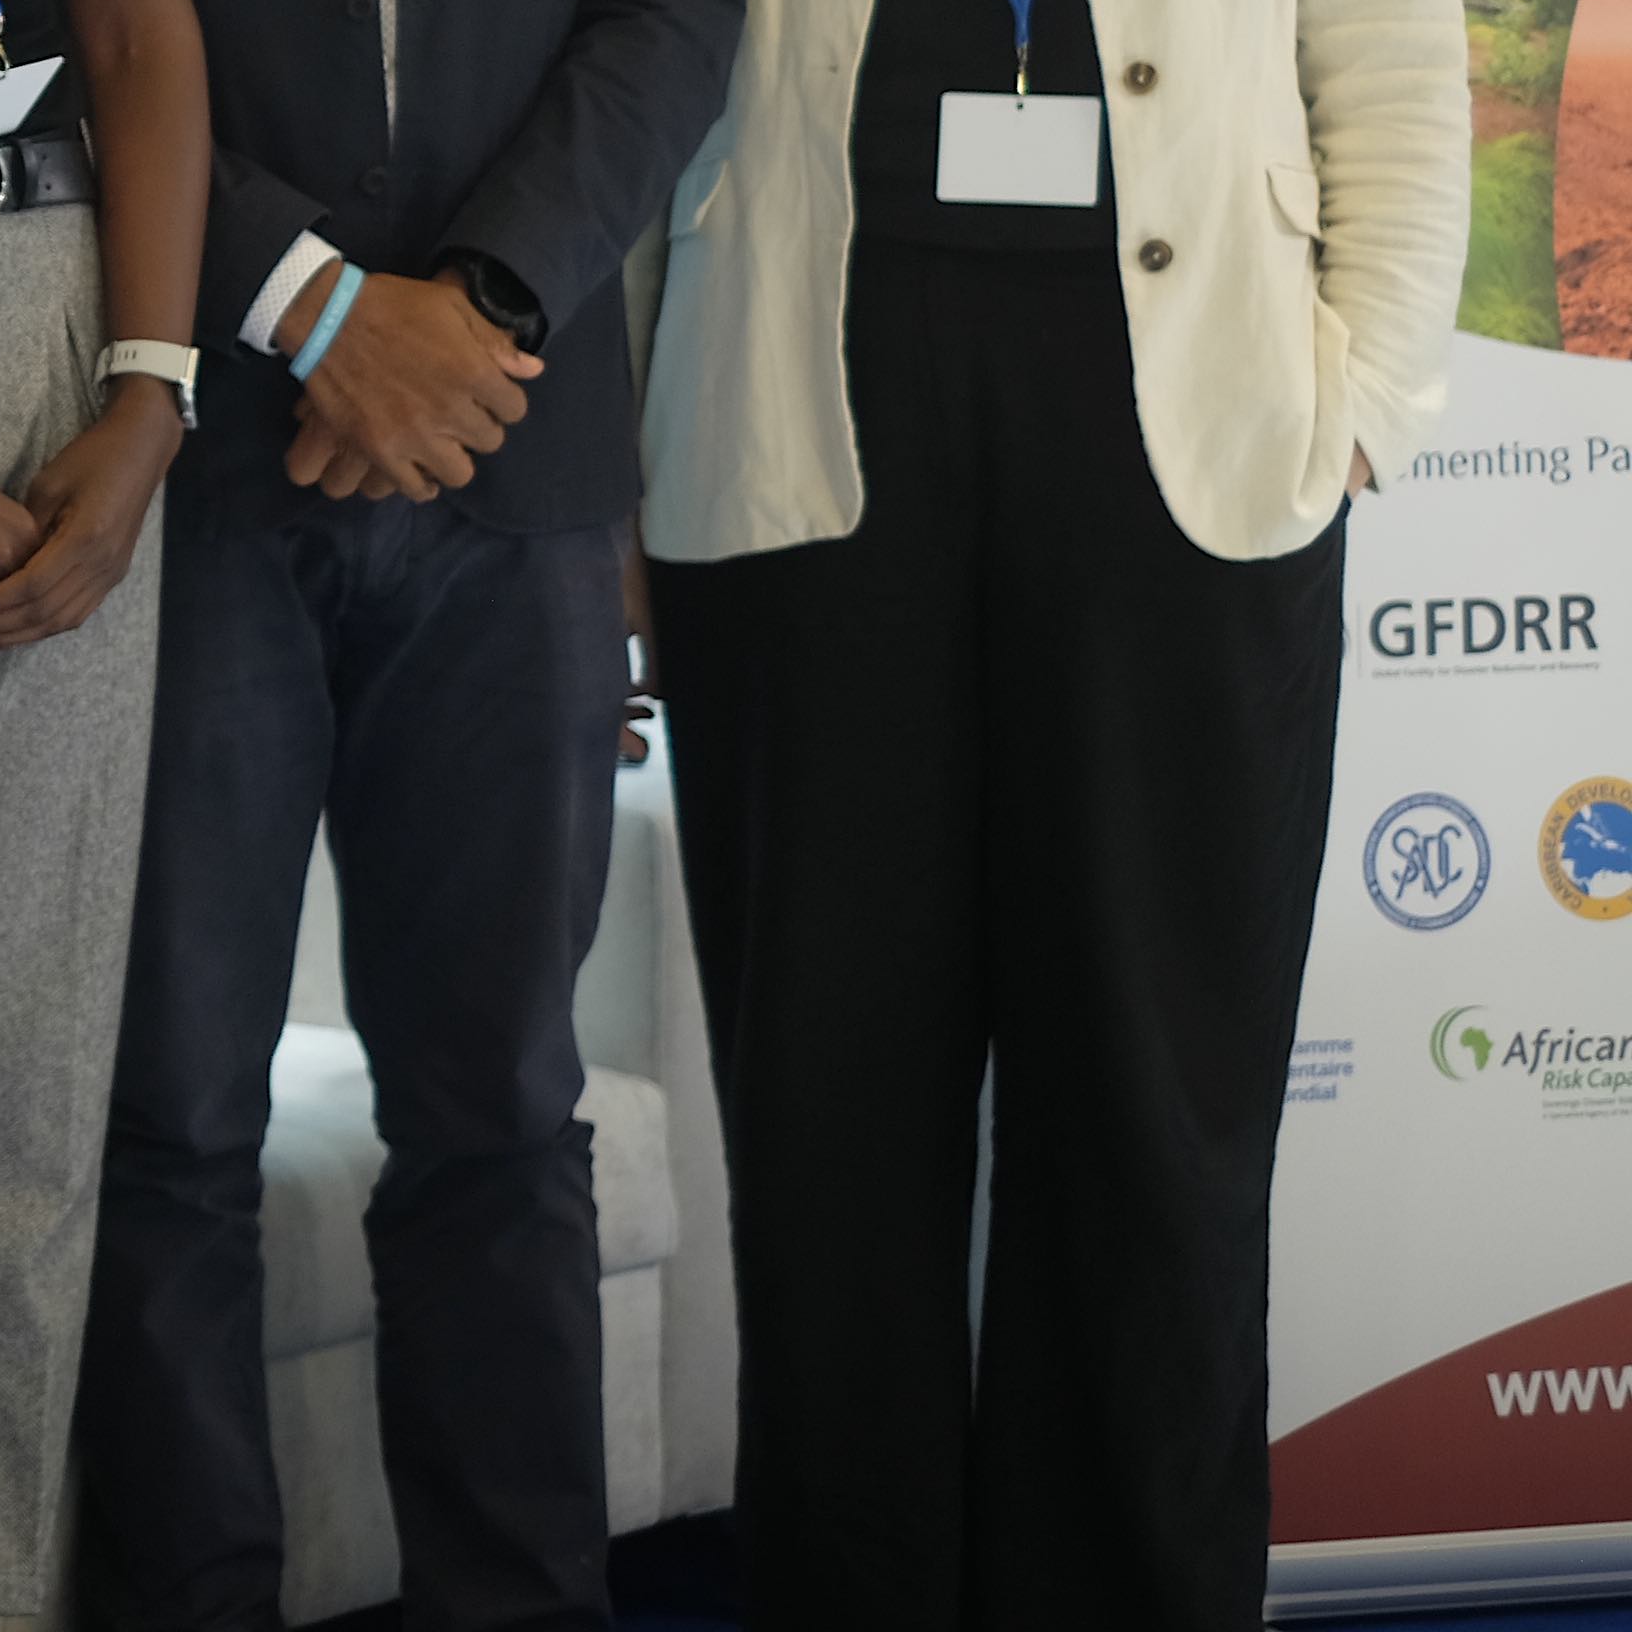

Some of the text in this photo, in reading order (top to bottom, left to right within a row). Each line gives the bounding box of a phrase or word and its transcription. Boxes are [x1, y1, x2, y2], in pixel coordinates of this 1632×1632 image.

[1411, 440, 1571, 485] menting
[1368, 594, 1599, 658] GFDRR
[1541, 1068, 1584, 1090] Risk
